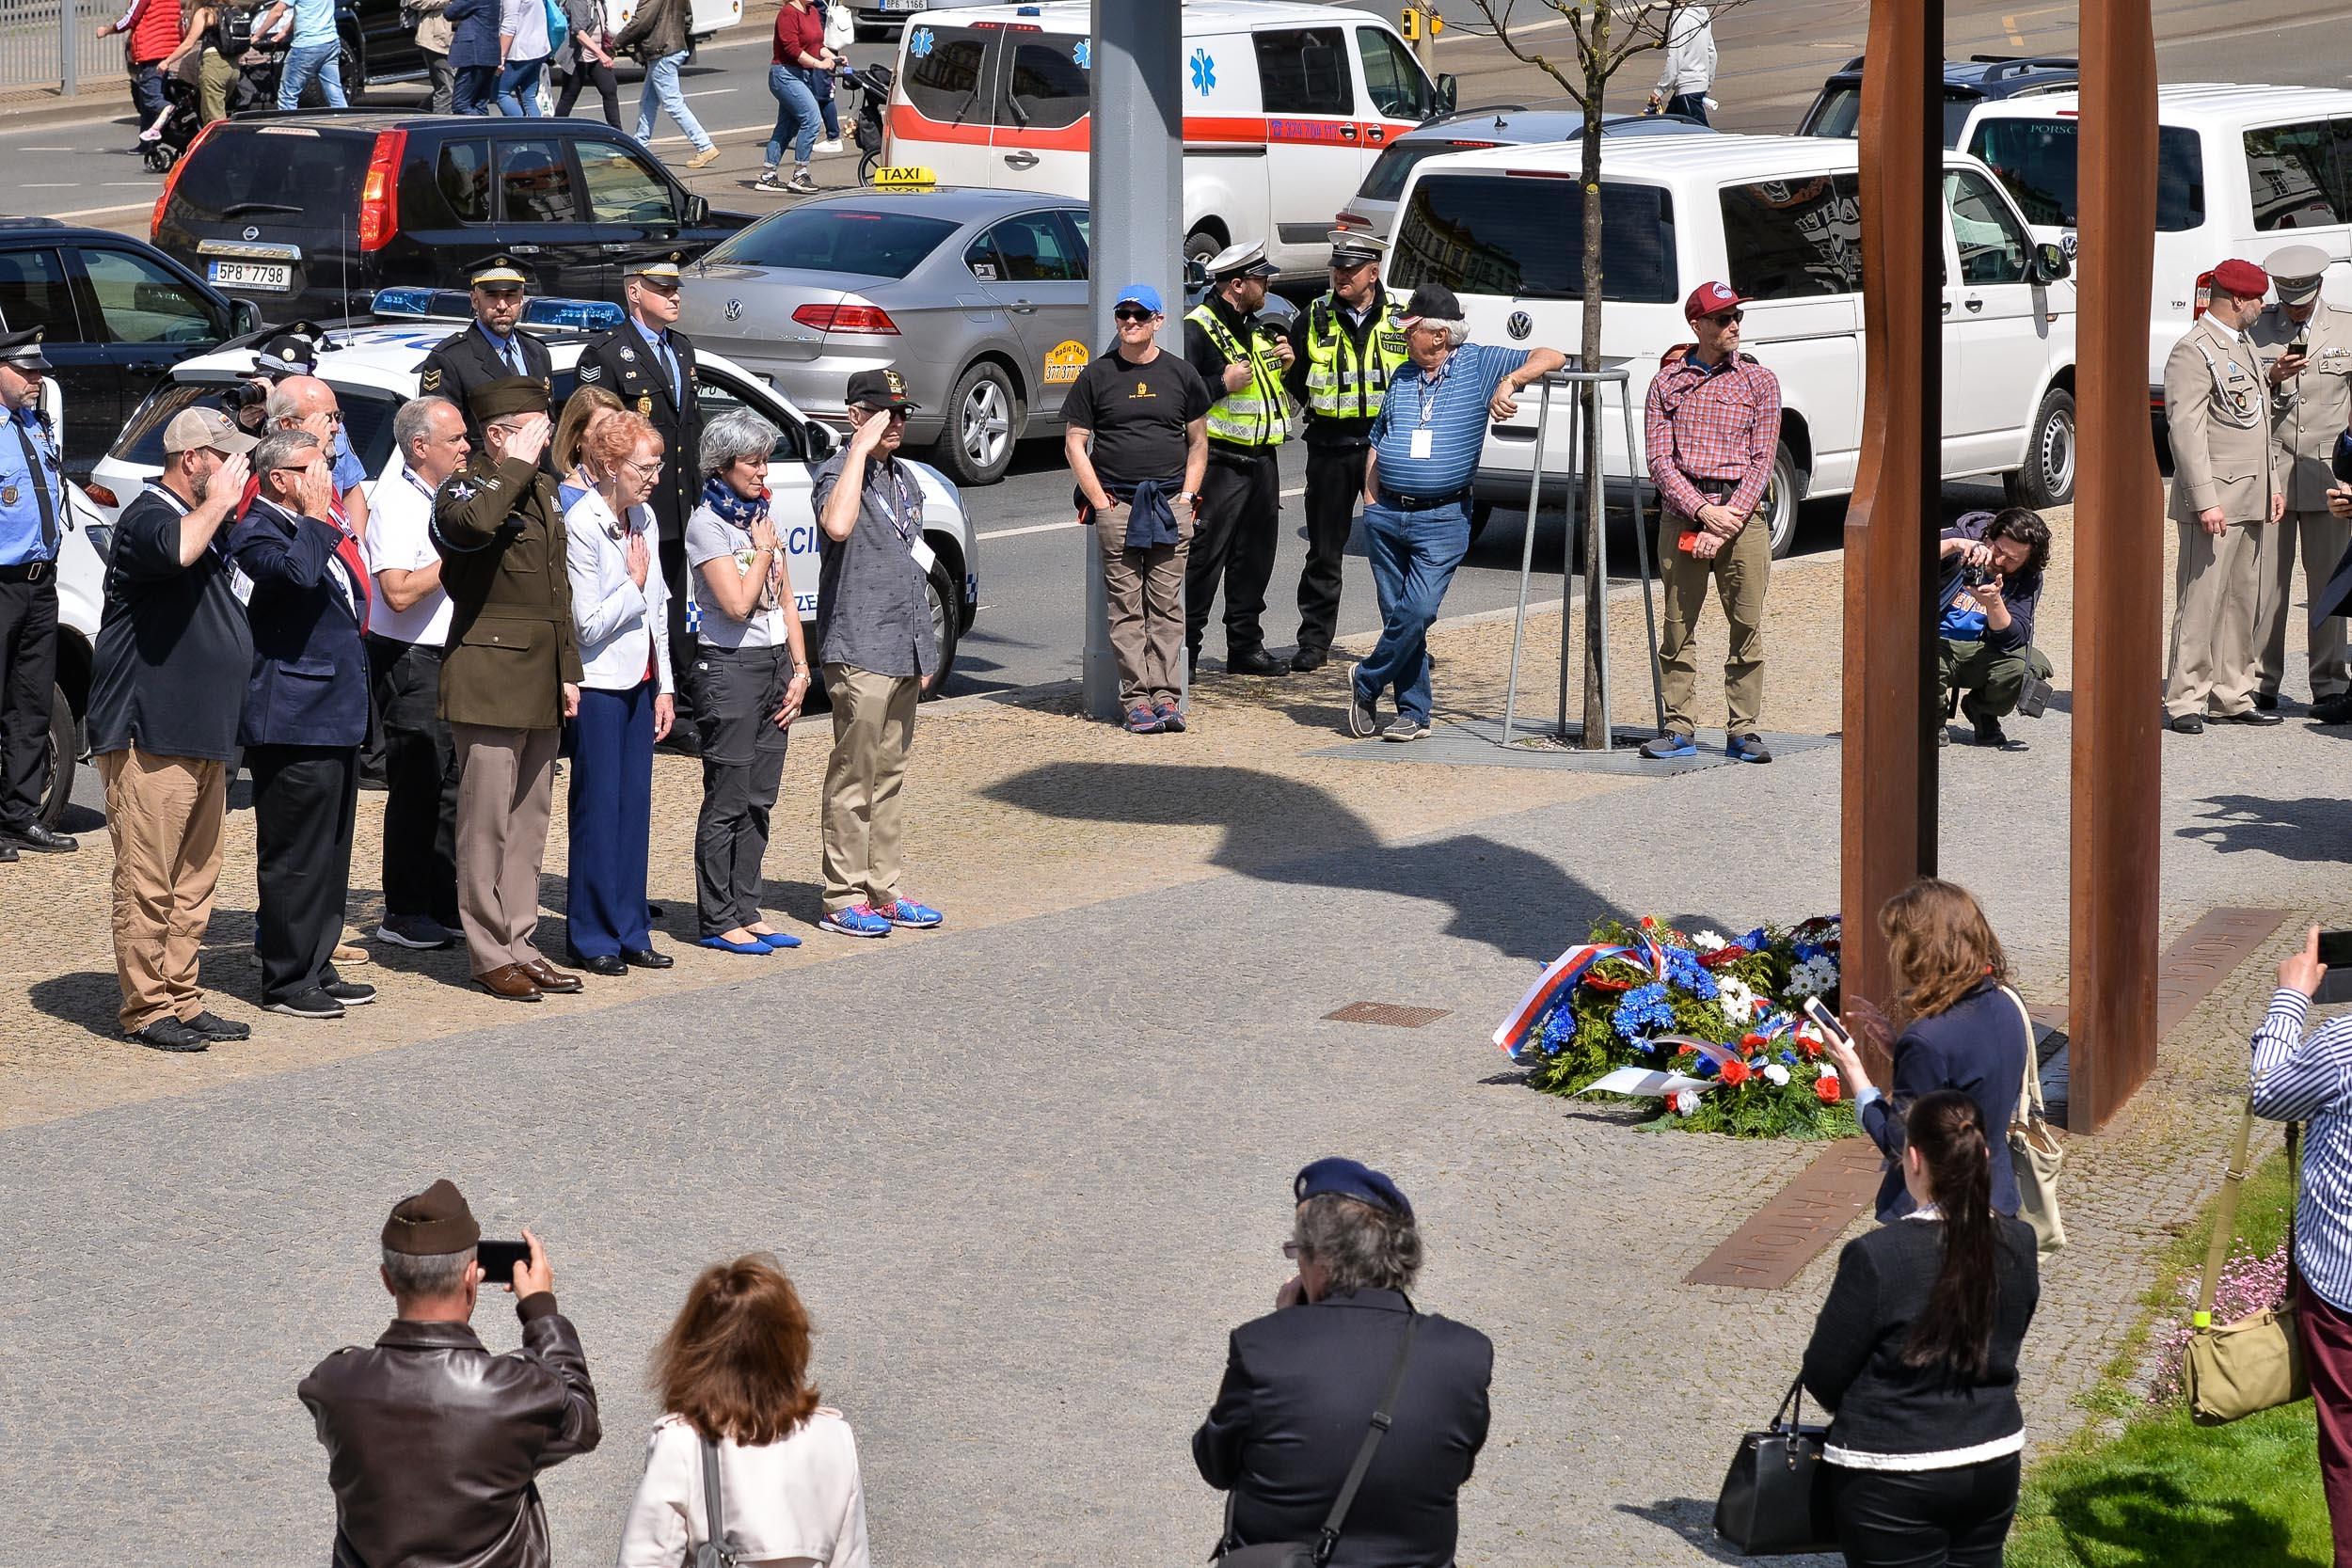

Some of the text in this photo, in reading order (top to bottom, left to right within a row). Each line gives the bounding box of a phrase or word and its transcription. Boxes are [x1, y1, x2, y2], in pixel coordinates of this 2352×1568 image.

[2030, 124, 2078, 135] PORSC
[881, 167, 920, 181] TAXI
[219, 264, 284, 283] 5P8 7798
[1046, 365, 1060, 379] 377
[1062, 365, 1075, 379] 377
[1717, 1189, 1855, 1274] PATTONA
